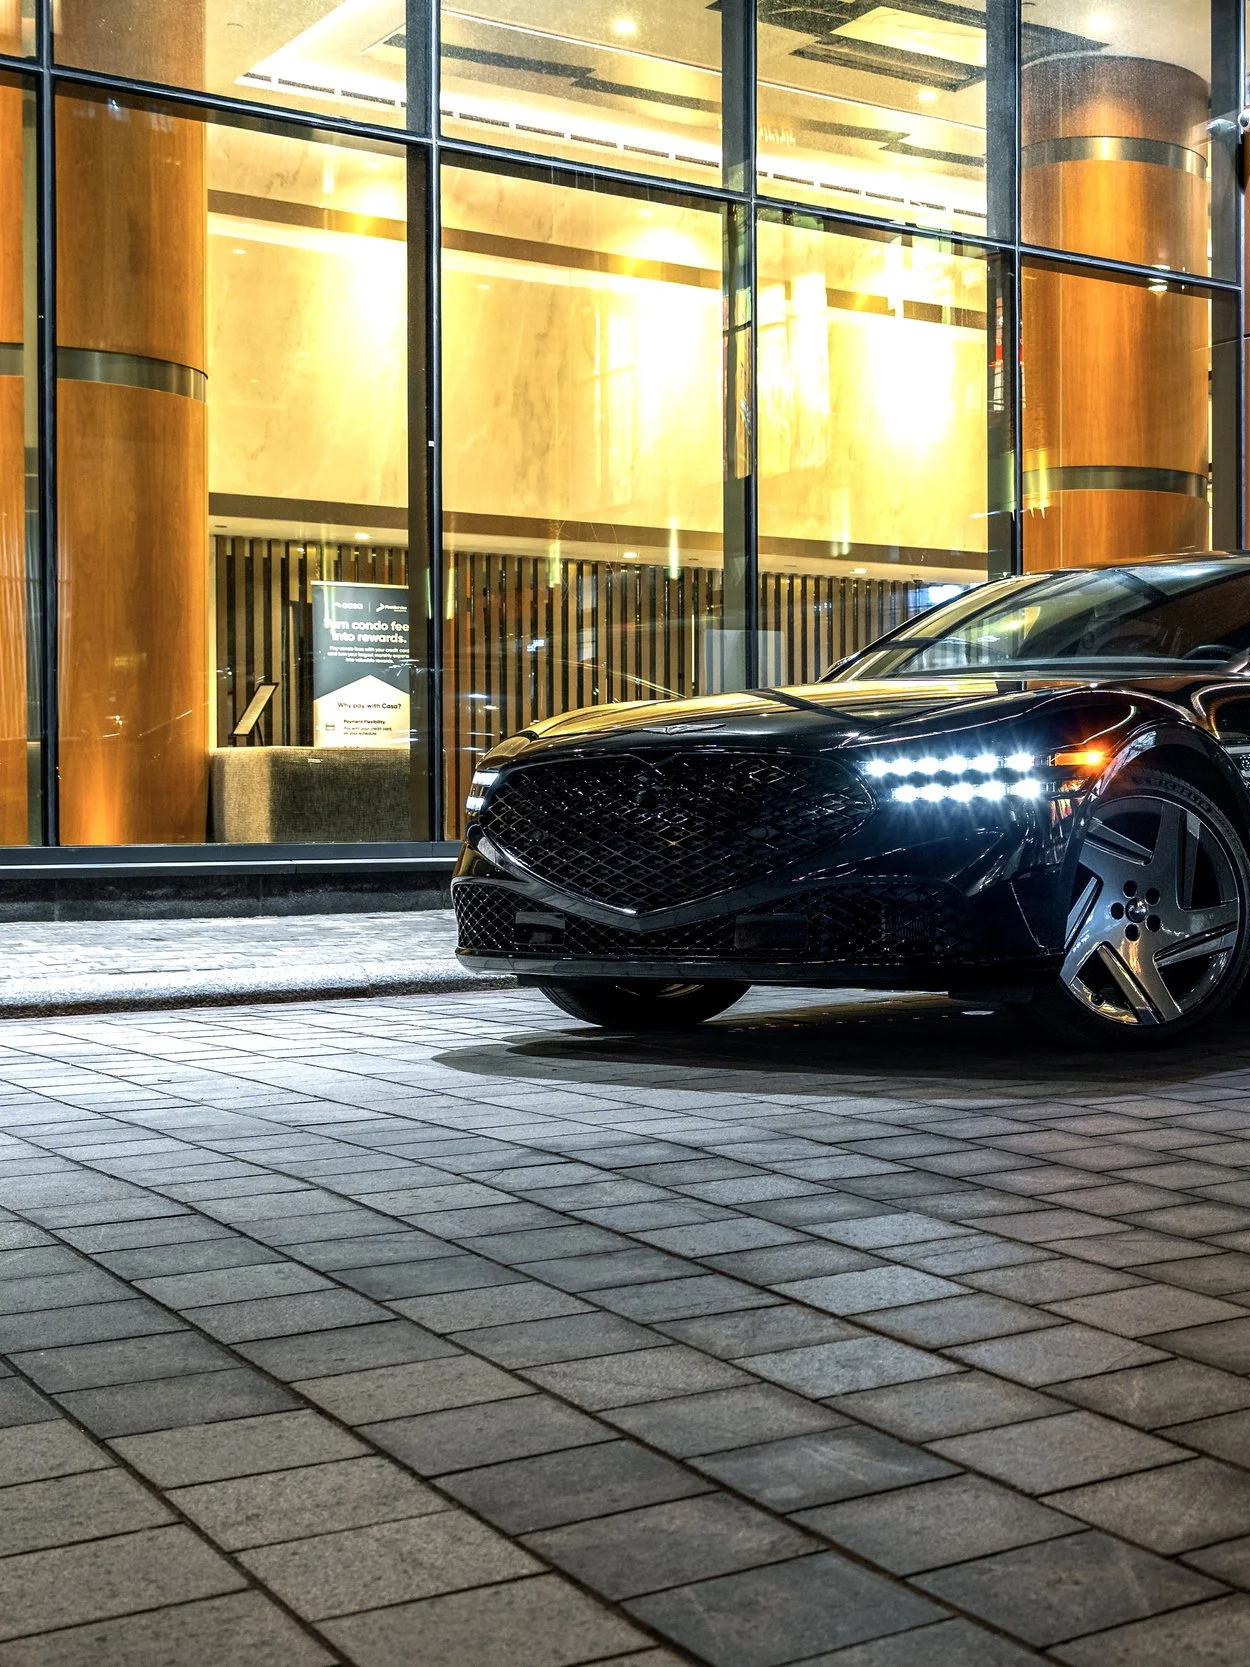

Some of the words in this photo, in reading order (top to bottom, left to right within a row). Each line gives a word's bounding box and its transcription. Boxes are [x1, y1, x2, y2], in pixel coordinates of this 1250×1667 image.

[351, 620, 388, 630] condo
[332, 632, 355, 641] into
[357, 633, 407, 643] rewards.
